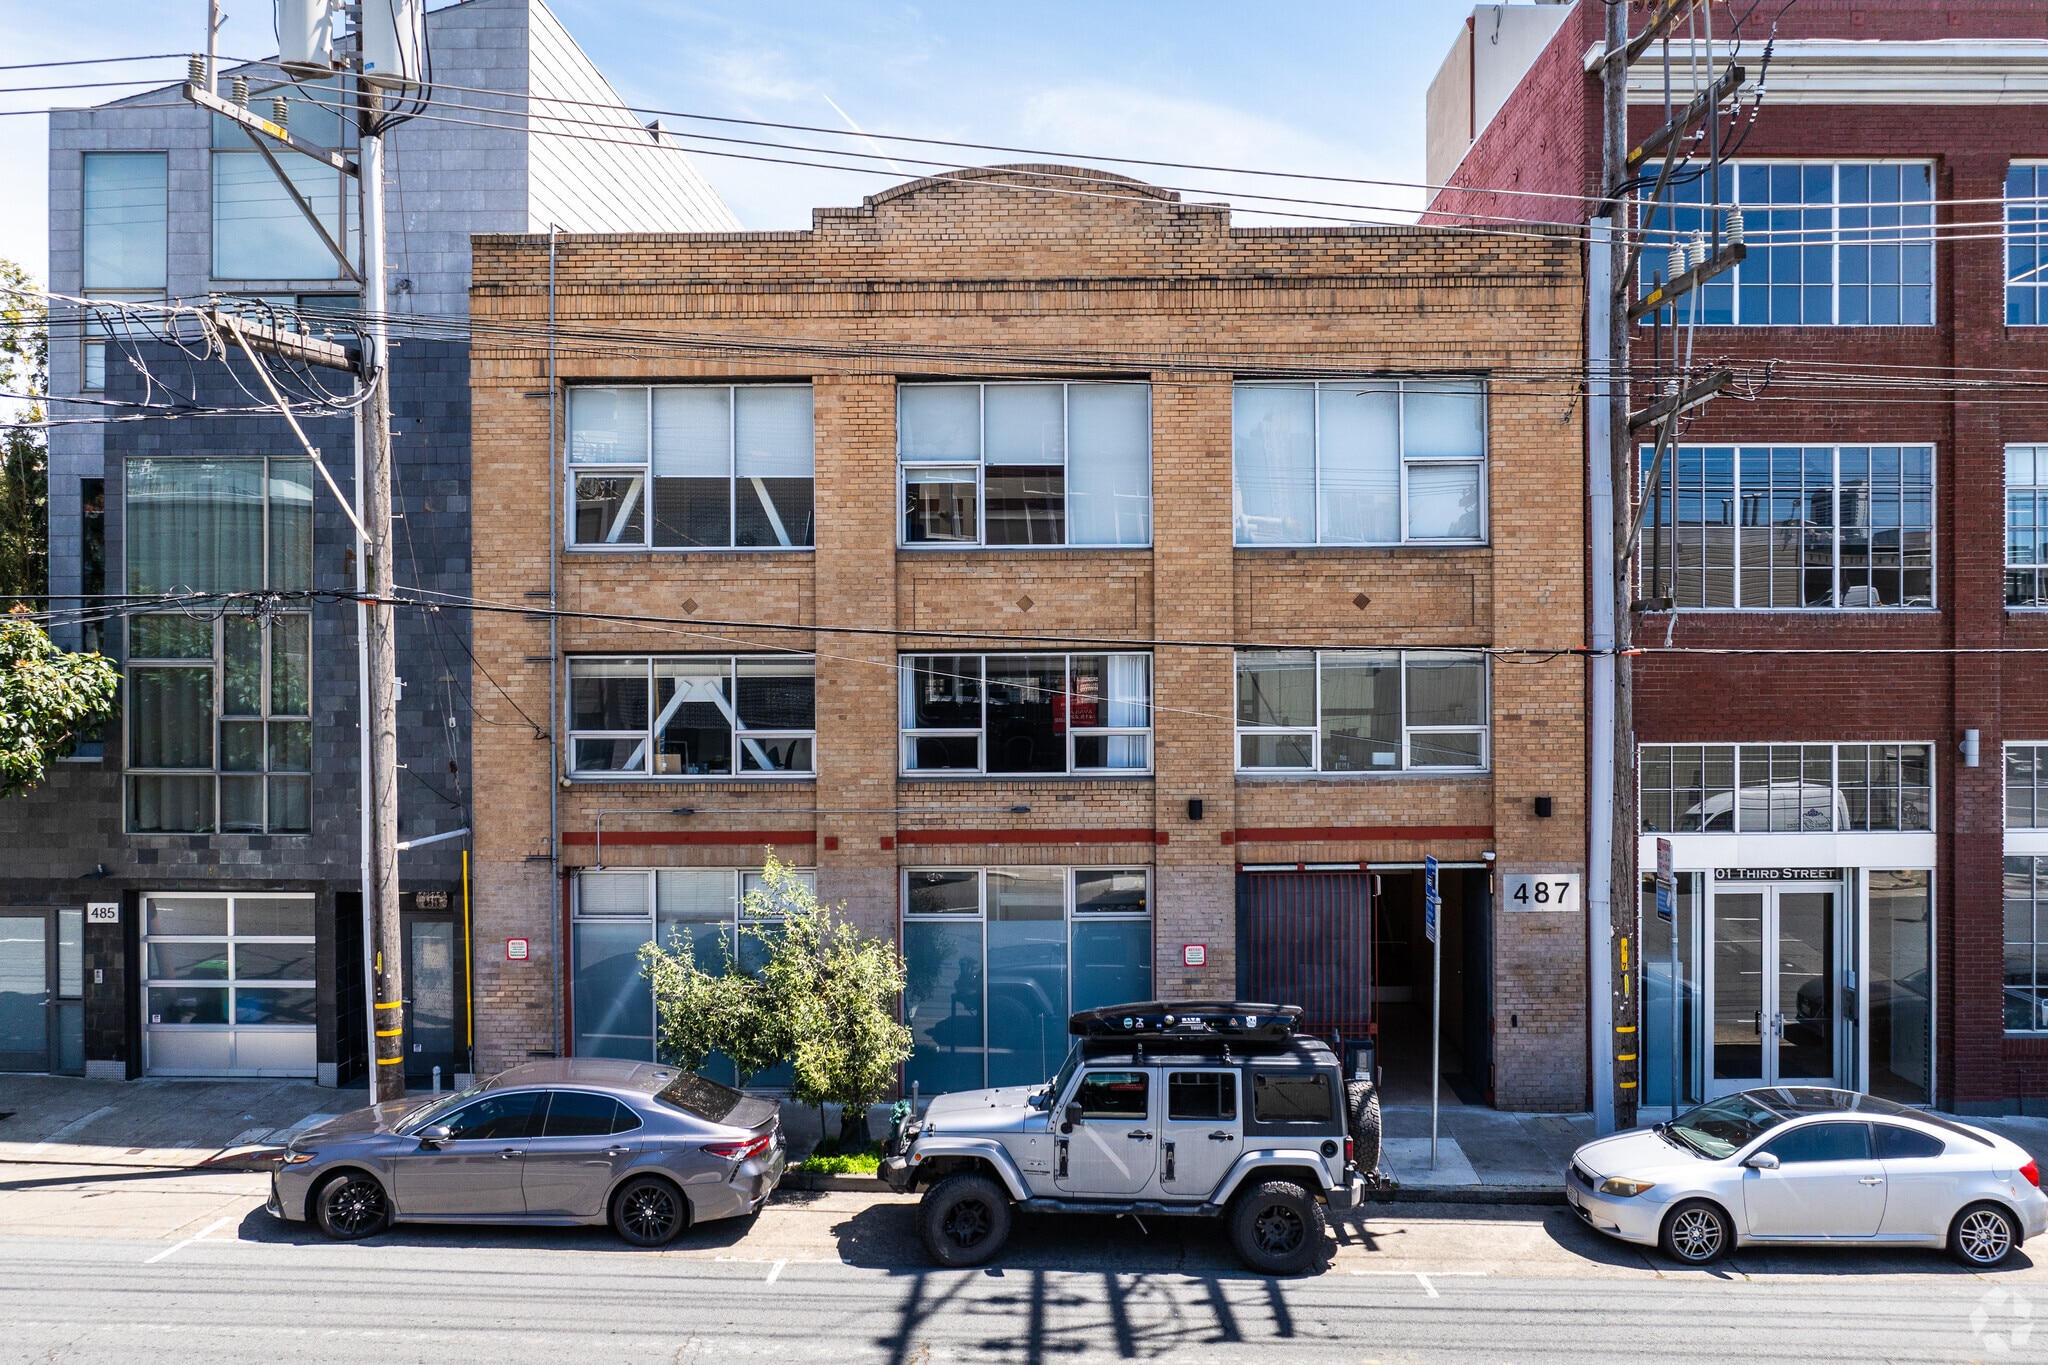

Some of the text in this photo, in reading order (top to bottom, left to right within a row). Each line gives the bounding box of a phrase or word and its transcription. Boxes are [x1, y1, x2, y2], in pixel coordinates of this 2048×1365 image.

[1737, 868, 1779, 879] THIRD
[1782, 868, 1835, 878] STREET
[1513, 881, 1570, 904] 487
[91, 907, 115, 919] 485
